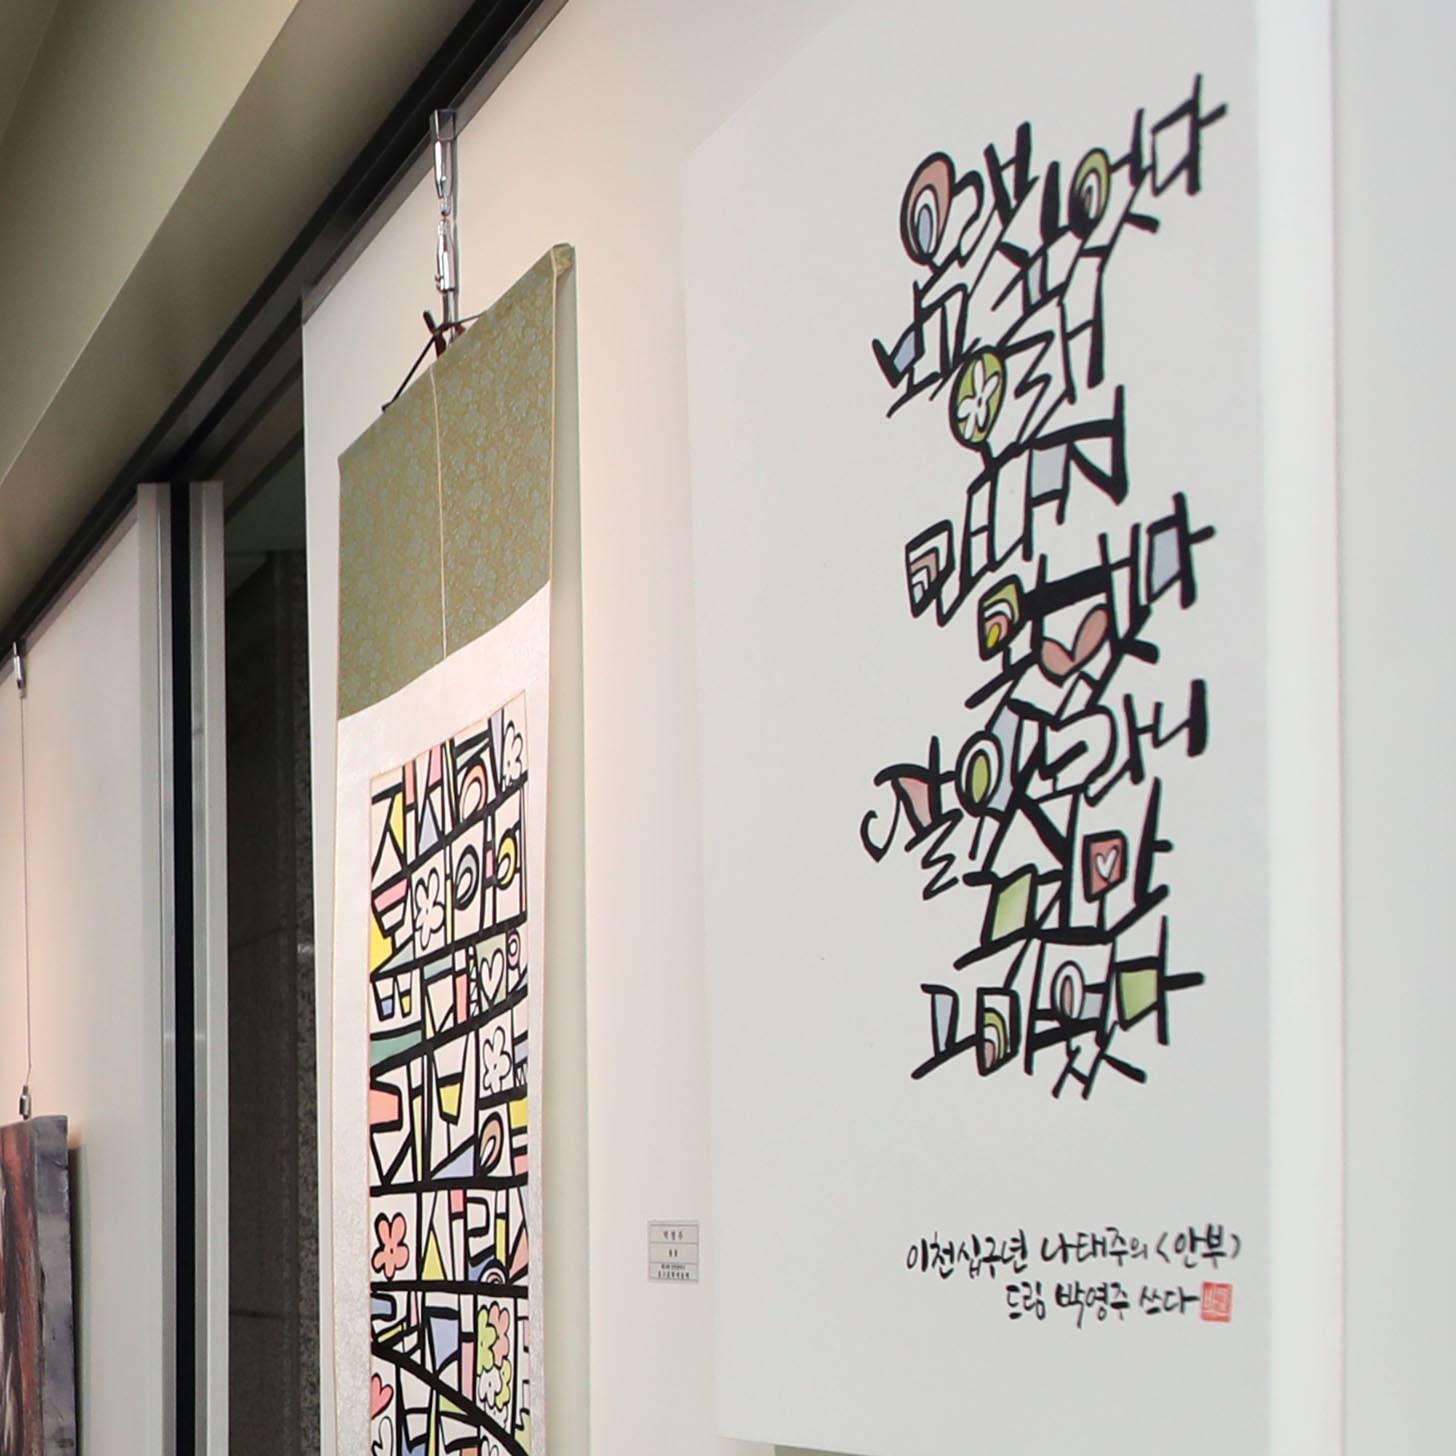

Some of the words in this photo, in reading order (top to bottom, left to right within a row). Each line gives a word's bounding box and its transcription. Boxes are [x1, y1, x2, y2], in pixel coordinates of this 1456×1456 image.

[906, 1229, 1028, 1279] 이천십구년
[1041, 1227, 1149, 1267] 나태주의
[1005, 1281, 1046, 1320] 드림
[1055, 1281, 1131, 1329] 박영주
[1139, 1284, 1200, 1316] 쓰다
